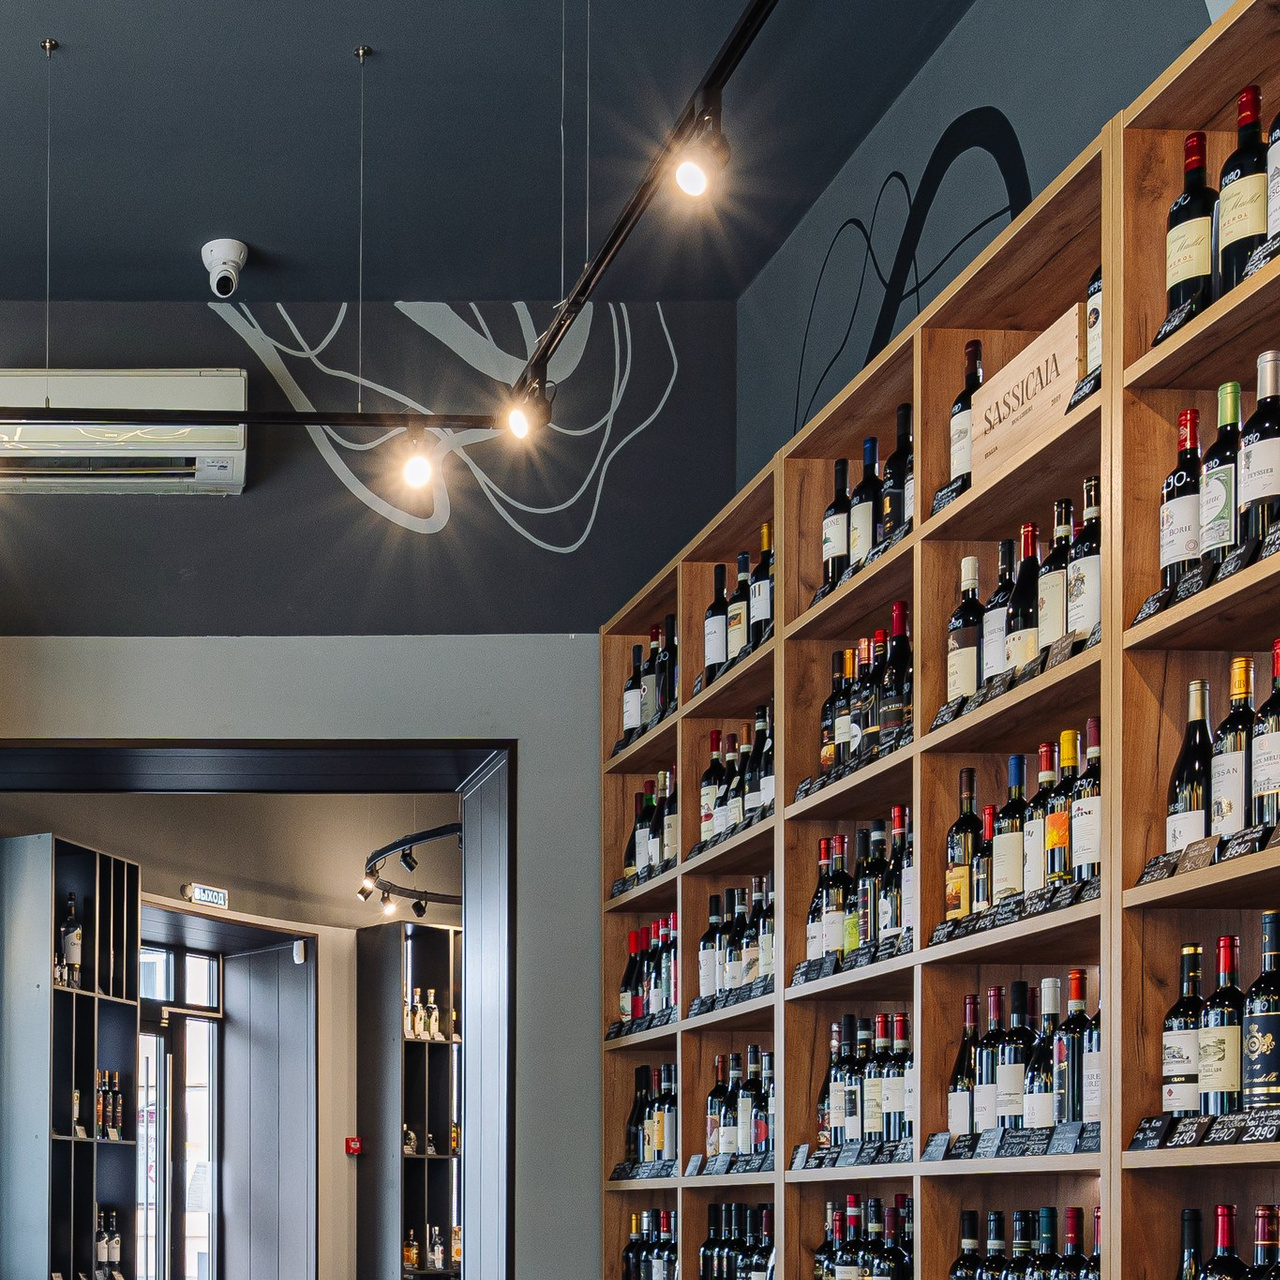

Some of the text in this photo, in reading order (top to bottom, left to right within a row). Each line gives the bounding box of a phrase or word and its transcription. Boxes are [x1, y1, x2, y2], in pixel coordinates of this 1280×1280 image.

[983, 353, 1061, 435] SASSICAIA
[194, 887, 225, 906] ВЫХОД
[1243, 1127, 1276, 1141] 2990
